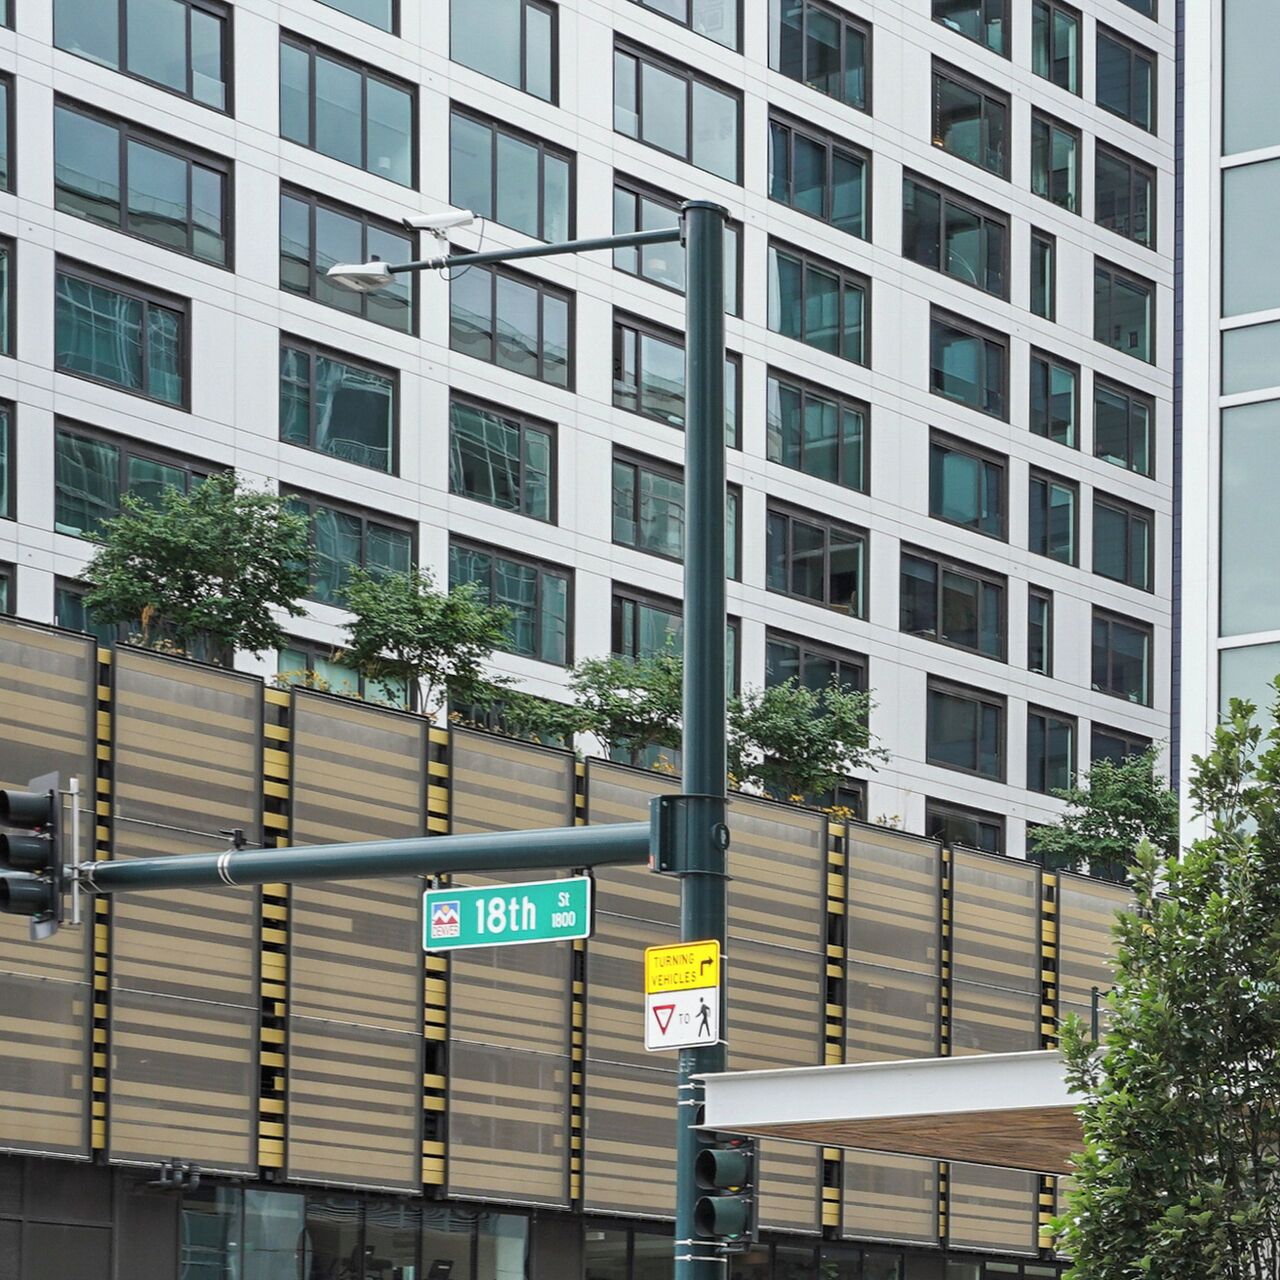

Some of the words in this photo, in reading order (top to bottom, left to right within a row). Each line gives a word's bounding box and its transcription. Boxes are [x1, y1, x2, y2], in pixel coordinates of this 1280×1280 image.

[475, 896, 536, 934] 18th
[557, 892, 571, 907] St
[551, 911, 576, 929] 1800
[653, 952, 695, 968] TURNING
[651, 971, 697, 987] VEHICLES
[679, 1013, 690, 1025] TO
